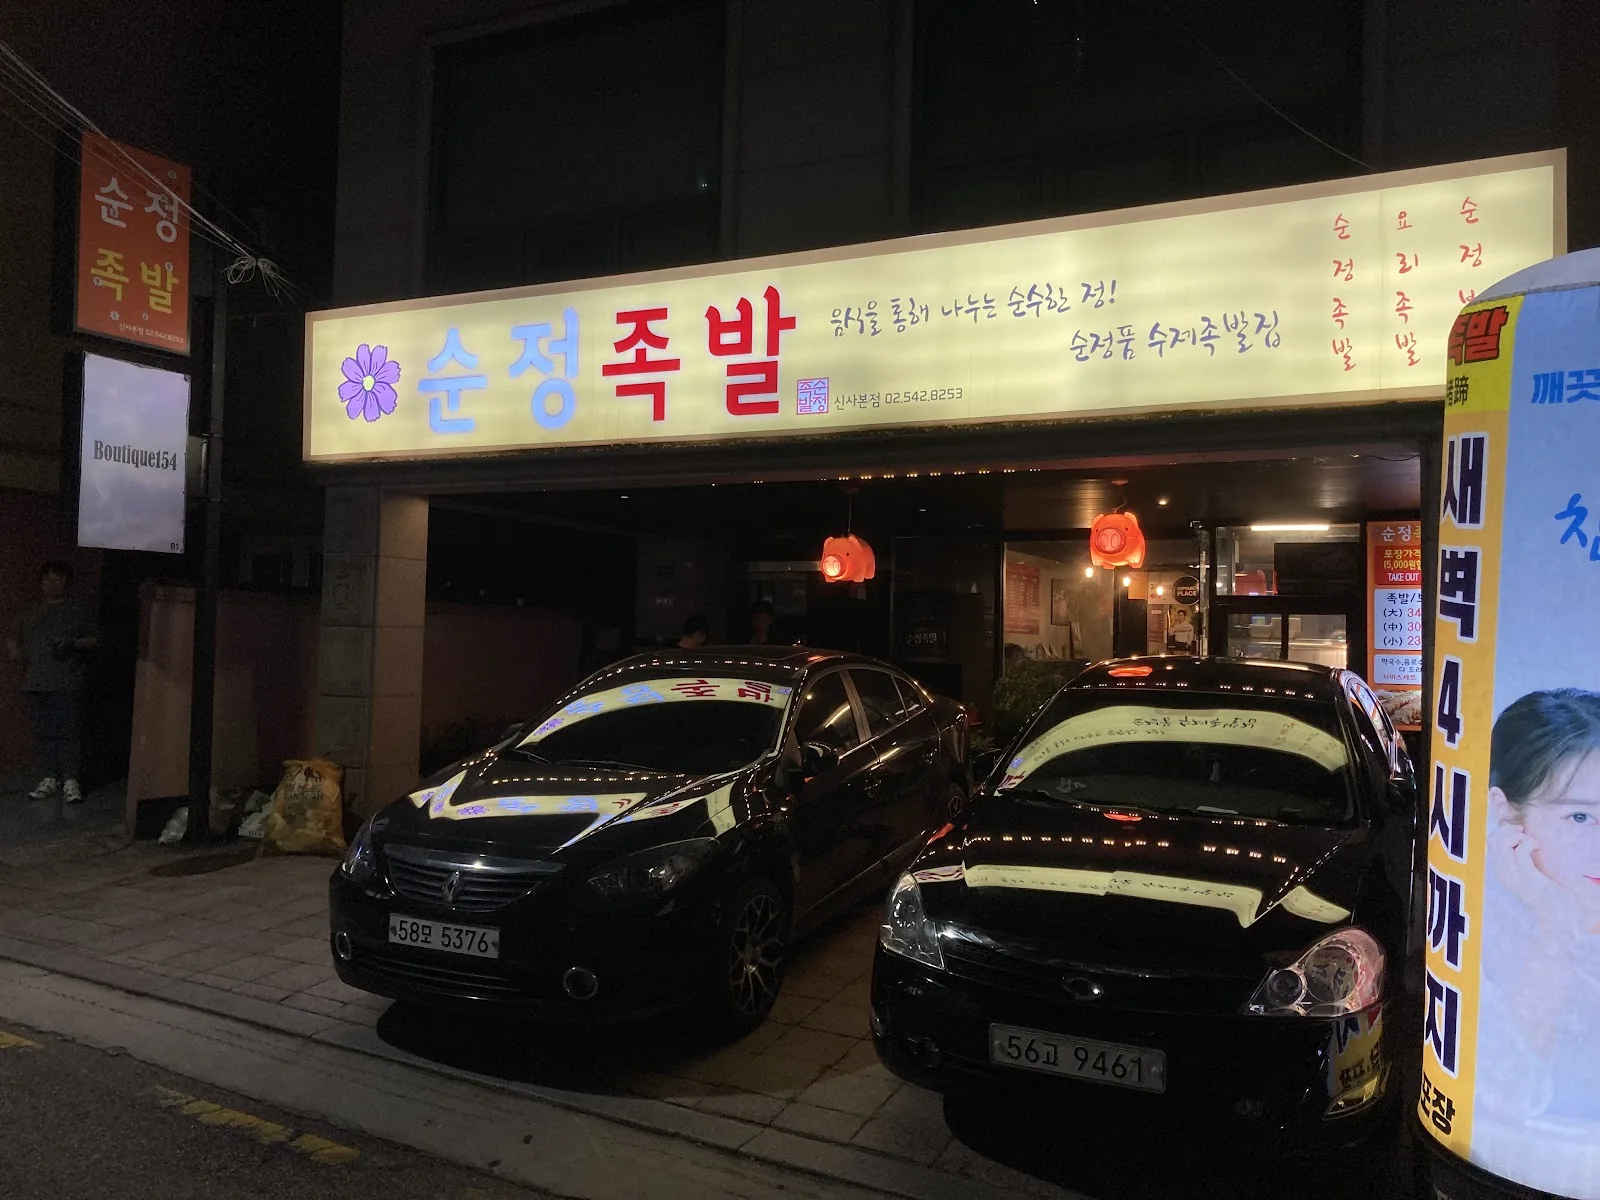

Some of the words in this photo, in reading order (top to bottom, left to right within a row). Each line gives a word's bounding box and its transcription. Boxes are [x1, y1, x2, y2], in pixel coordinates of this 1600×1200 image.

[94, 176, 180, 243] 순정
[1459, 197, 1482, 303] 순정
[90, 247, 179, 314] 족발
[830, 300, 883, 337] 음식을
[890, 297, 930, 333] 통해
[941, 293, 996, 323] 나누는
[1007, 283, 1071, 318] 순수한
[1080, 279, 1117, 308] 정!
[119, 322, 144, 336] 신사본점
[1069, 324, 1136, 362] 순정품
[1147, 310, 1282, 358] 수제족발집
[834, 392, 881, 411] 신사본점
[885, 387, 963, 404] 02.542.8253
[93, 440, 178, 471] Boutique154
[170, 542, 180, 551] B1
[1387, 572, 1404, 582] TAKE
[1405, 572, 1420, 582] OUT
[1383, 608, 1403, 618] (大)
[1383, 622, 1403, 632] (中)
[1383, 636, 1403, 646] (小)
[398, 920, 432, 944] 58모
[441, 926, 489, 953] 5376
[1007, 1035, 1058, 1066] 56고
[1074, 1047, 1143, 1082] 9461
